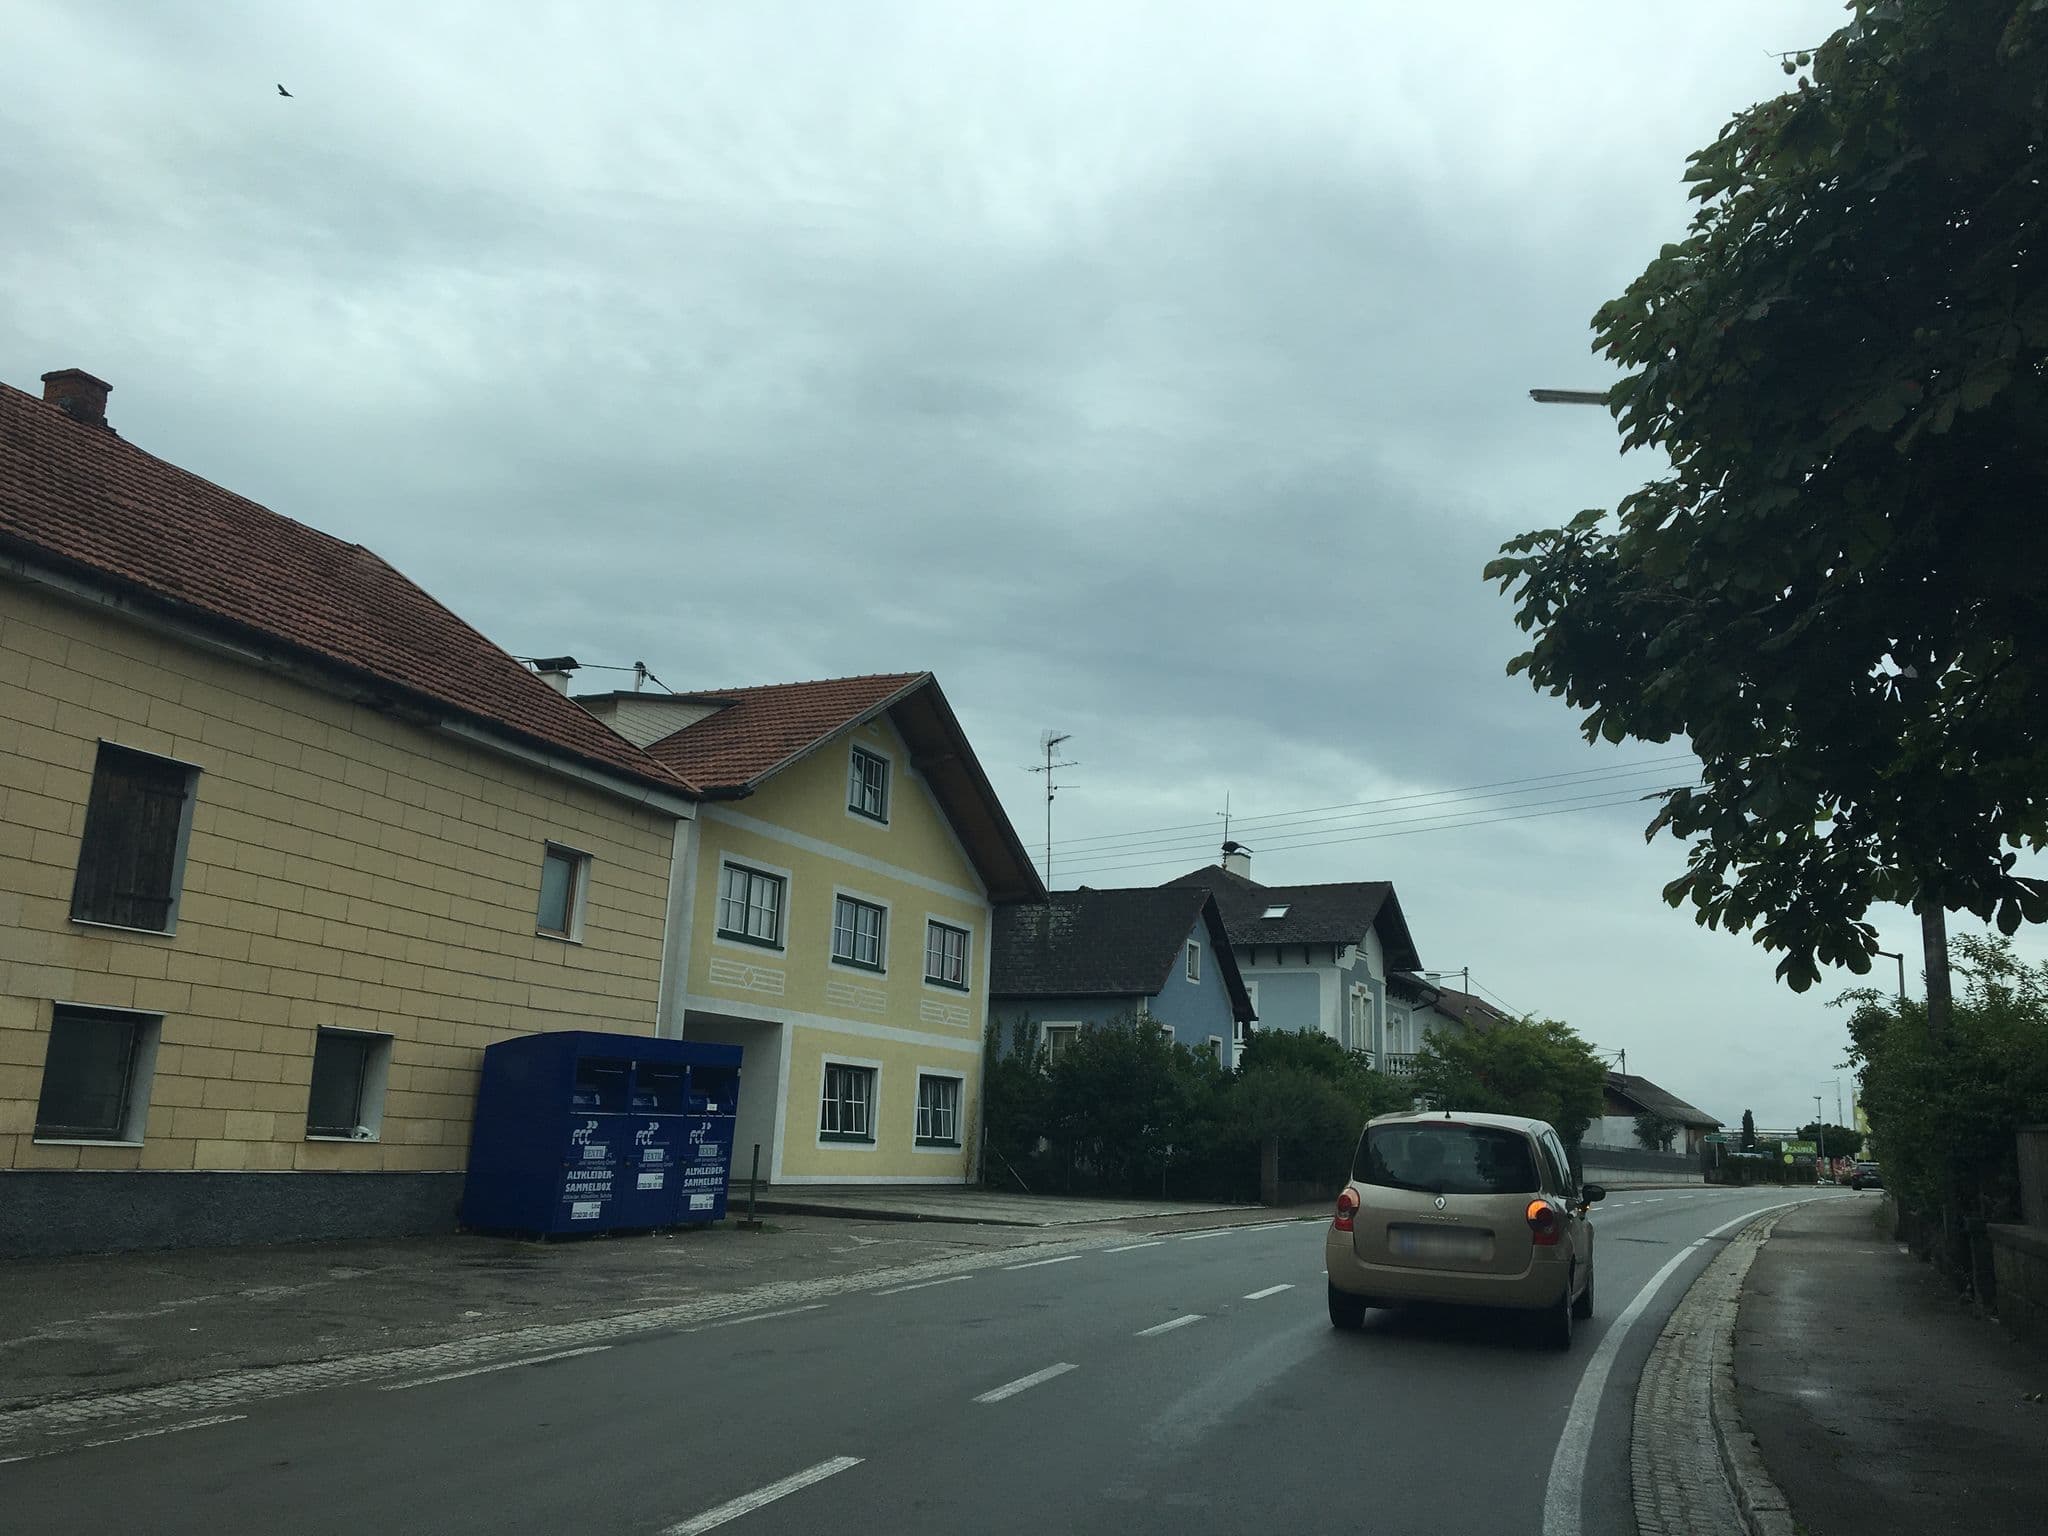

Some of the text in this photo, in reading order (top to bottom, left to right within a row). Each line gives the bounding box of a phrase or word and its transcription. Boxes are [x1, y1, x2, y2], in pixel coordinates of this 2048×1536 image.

[571, 1129, 593, 1145] FCC
[635, 1130, 654, 1146] FCC
[567, 1170, 614, 1180] ALTKLEIDER-
[565, 1182, 612, 1192] SAMMELBOX
[683, 1176, 724, 1188] SAMMELBOX
